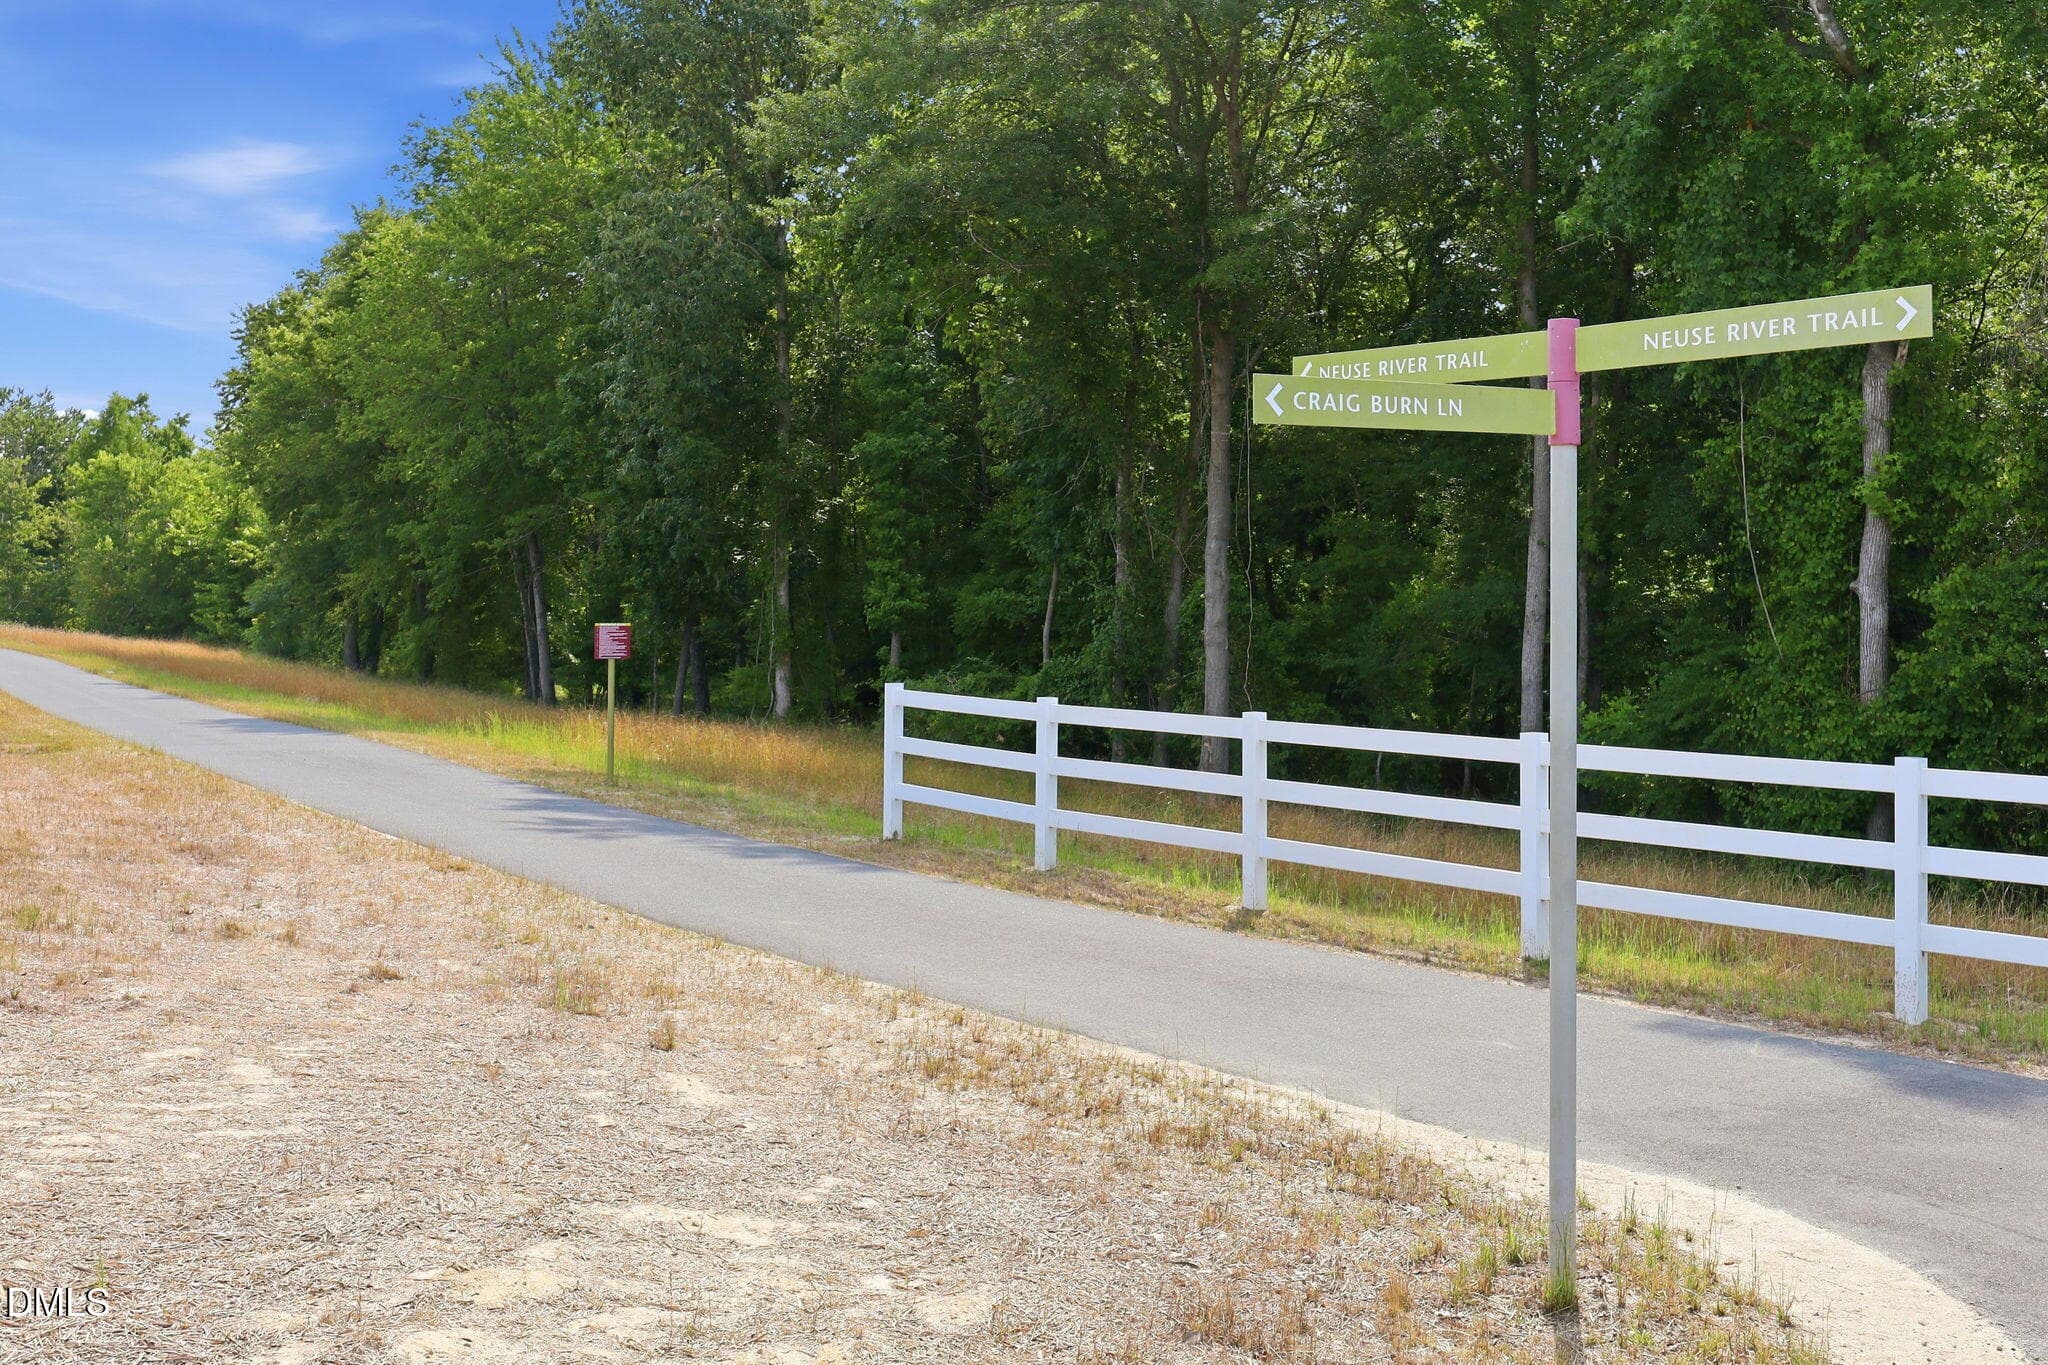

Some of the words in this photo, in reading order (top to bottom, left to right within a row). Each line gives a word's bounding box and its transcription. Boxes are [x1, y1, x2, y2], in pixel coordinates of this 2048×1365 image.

[1643, 326, 1716, 351] NEUSE
[1727, 316, 1797, 342] RIVER
[1807, 307, 1883, 333] TRAIL
[1319, 361, 1371, 379] NEUSE
[1378, 356, 1427, 377] RIVER
[1435, 350, 1489, 370] TRAIL
[1293, 391, 1360, 413] CRAIG
[1371, 395, 1428, 416] BURN
[1437, 397, 1462, 417] LN
